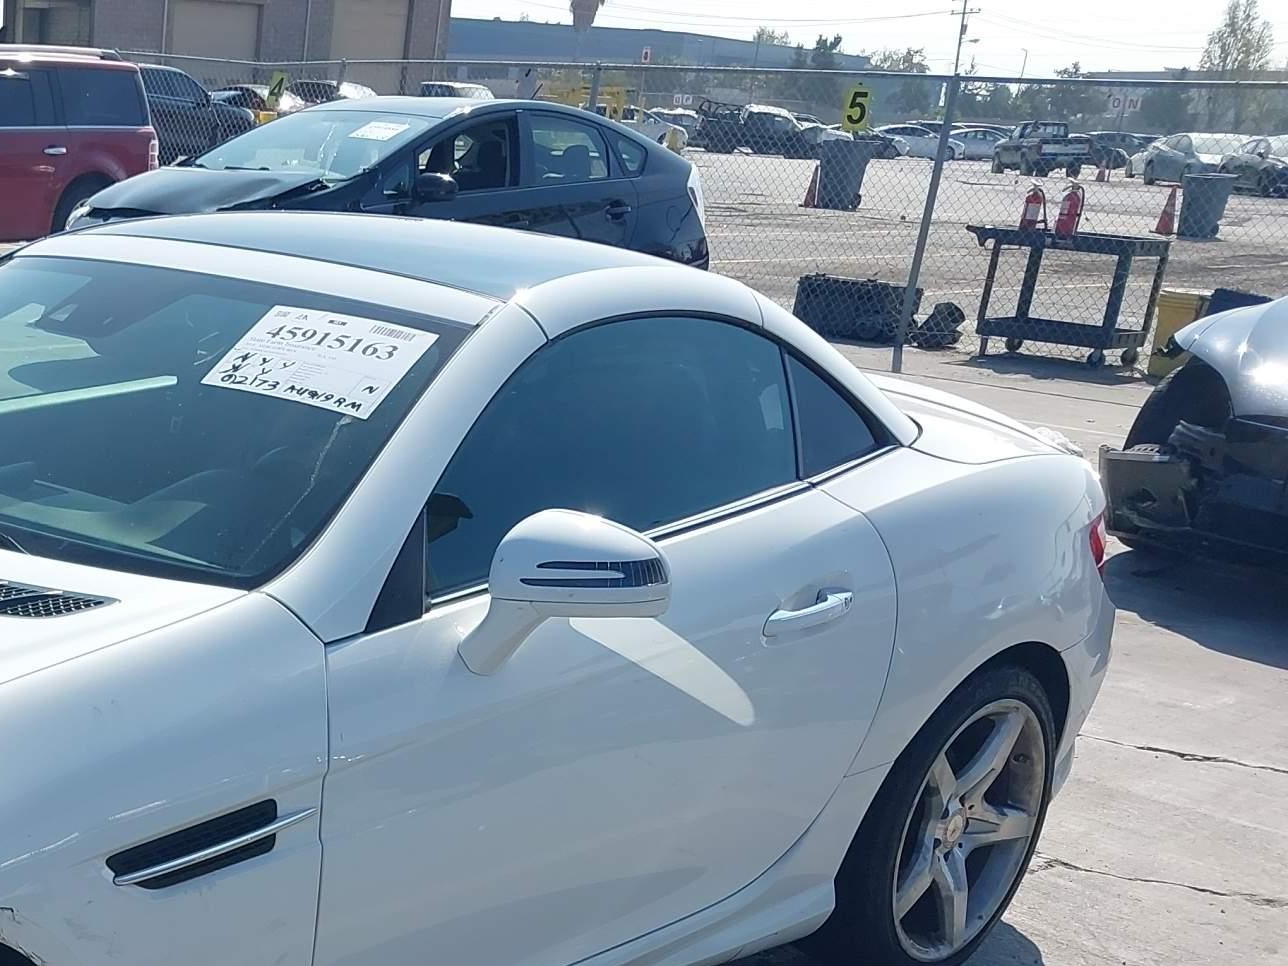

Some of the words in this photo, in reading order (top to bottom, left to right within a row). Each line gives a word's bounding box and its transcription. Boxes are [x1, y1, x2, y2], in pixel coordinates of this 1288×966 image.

[269, 77, 284, 102] 4
[847, 91, 869, 125] 5
[265, 324, 400, 361] 45915163
